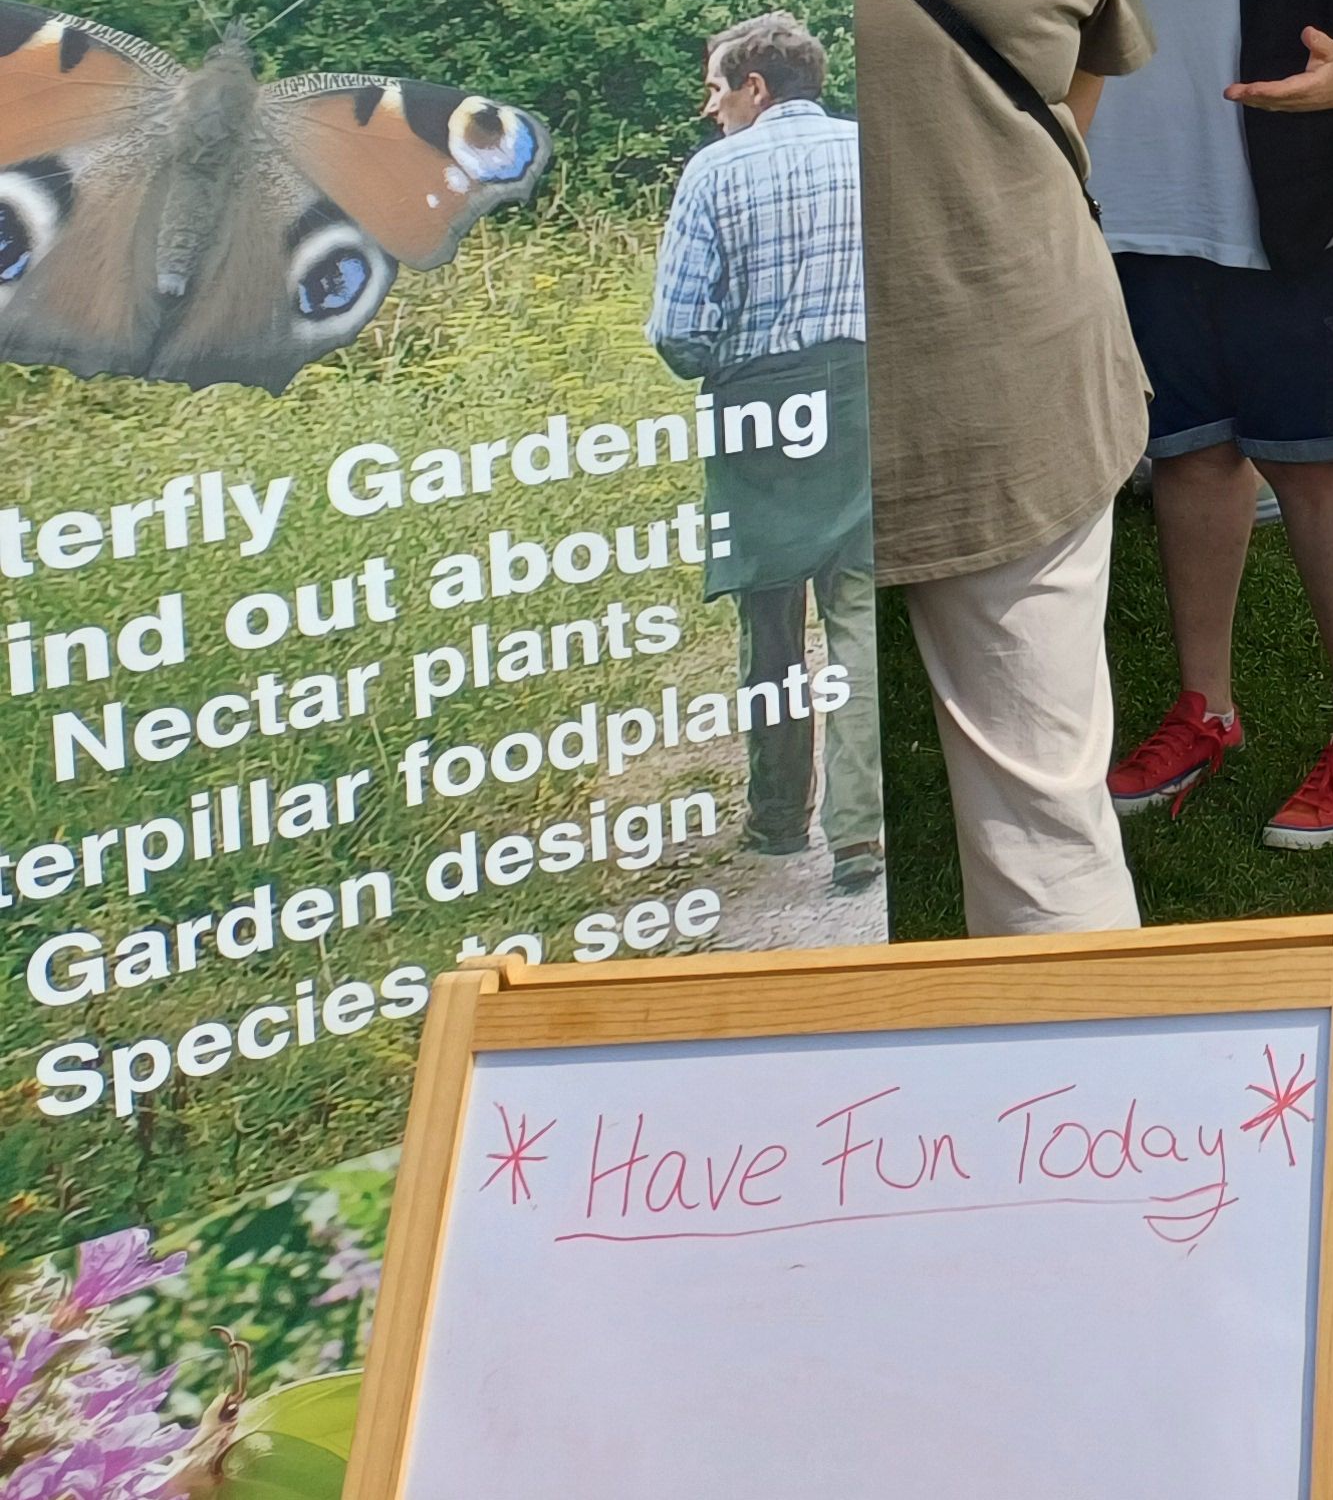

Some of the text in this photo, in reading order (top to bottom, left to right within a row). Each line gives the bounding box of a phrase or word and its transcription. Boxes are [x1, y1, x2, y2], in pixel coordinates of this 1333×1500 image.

[0, 389, 829, 580] terfly Gardening
[6, 502, 733, 696] ind out about:
[52, 600, 682, 782] Nectar plants
[0, 663, 852, 908] erpillar foodplants
[26, 791, 719, 1009] Garden design
[35, 963, 429, 1120] Species
[573, 888, 722, 963] see
[584, 1084, 1230, 1228] Have Fun Today
